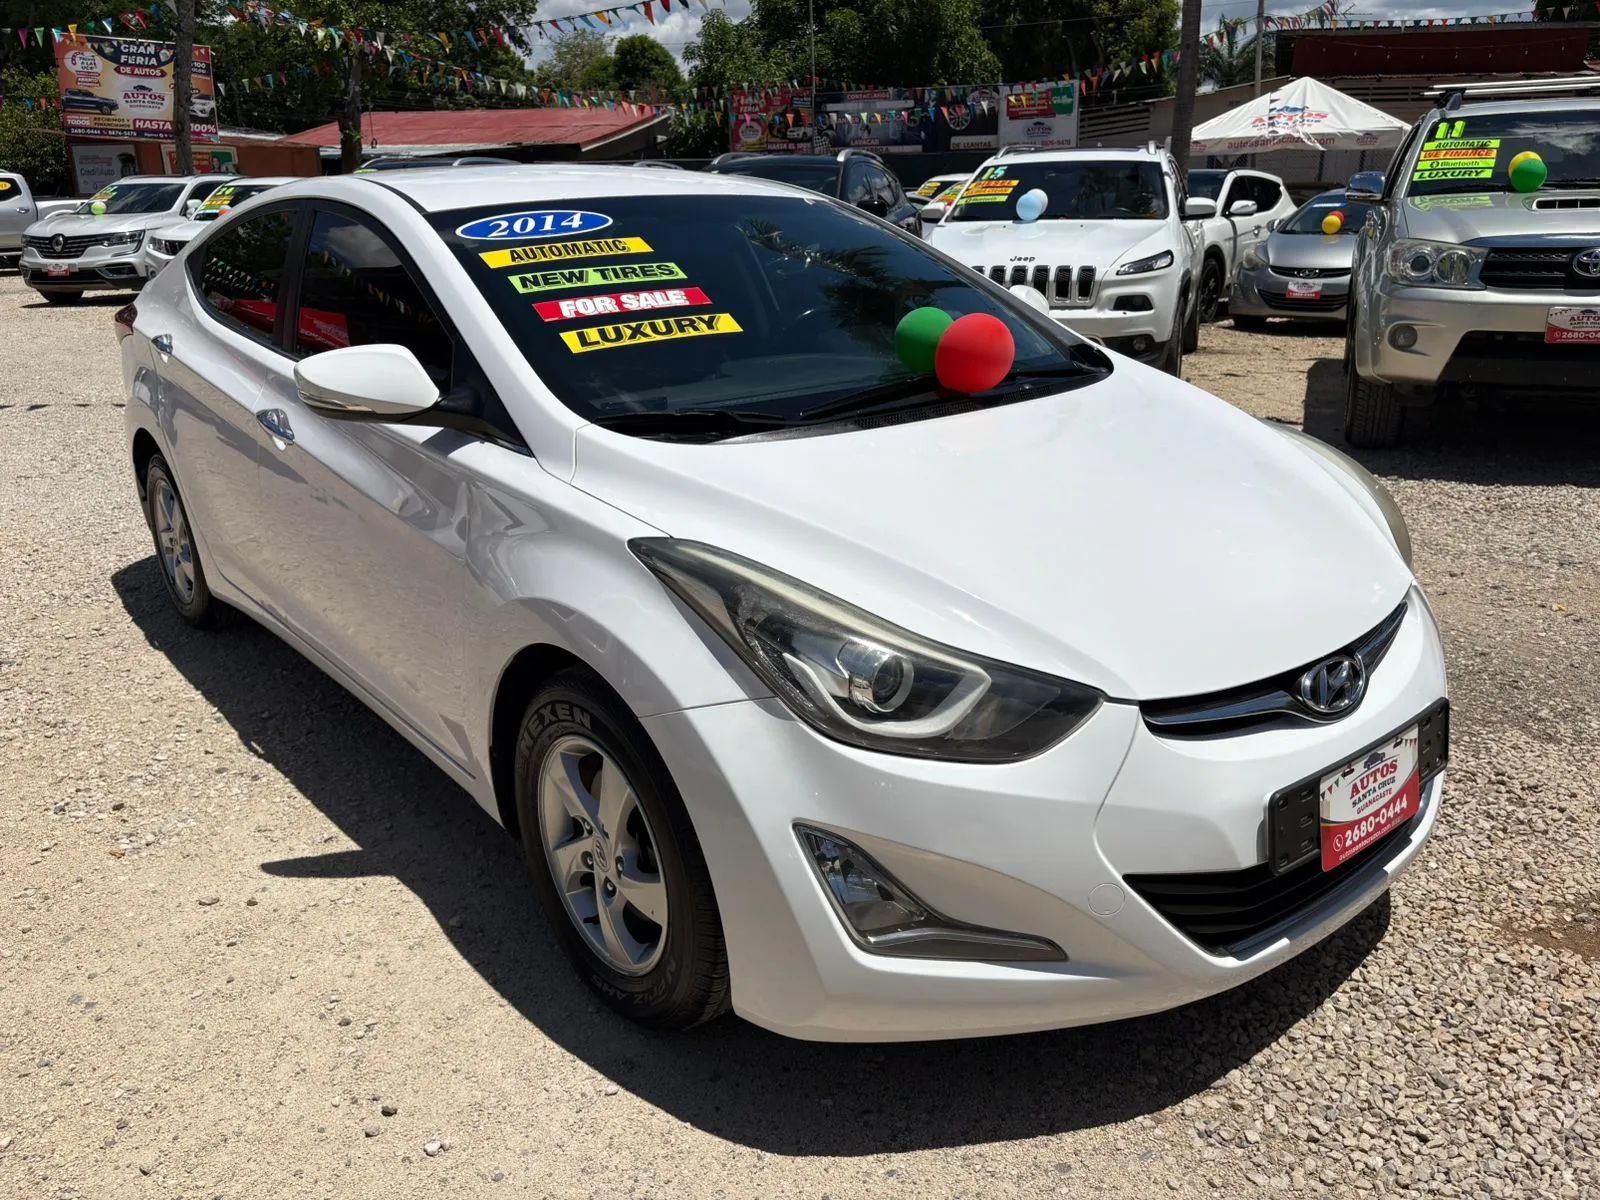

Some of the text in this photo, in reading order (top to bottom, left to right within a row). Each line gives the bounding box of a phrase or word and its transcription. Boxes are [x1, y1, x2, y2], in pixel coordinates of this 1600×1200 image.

[120, 44, 155, 55] GRAN
[120, 54, 158, 66] FERIA
[120, 66, 161, 77] DE AUTOS
[123, 92, 165, 101] AUTOS
[135, 119, 172, 130] HASTA
[190, 122, 216, 134] 100%
[1435, 140, 1492, 149] AUTOMATIC
[1423, 149, 1493, 159] WE FINANCE
[1440, 160, 1480, 168] Bluetooth
[1417, 169, 1485, 180] LUXURY
[487, 211, 584, 239] 2014
[510, 238, 629, 264] AUTOMATIC
[1009, 255, 1036, 264] Jeep
[518, 263, 678, 291] NEW TIRES
[558, 288, 690, 319] FOR SALE
[575, 314, 722, 349] LUXURY
[520, 702, 592, 753] NEXEN
[1350, 758, 1398, 800] AUTOS
[1352, 775, 1396, 808] SANTA CRUZ
[1356, 787, 1393, 815] GUANACASTE
[1345, 793, 1408, 848] 2680-0444
